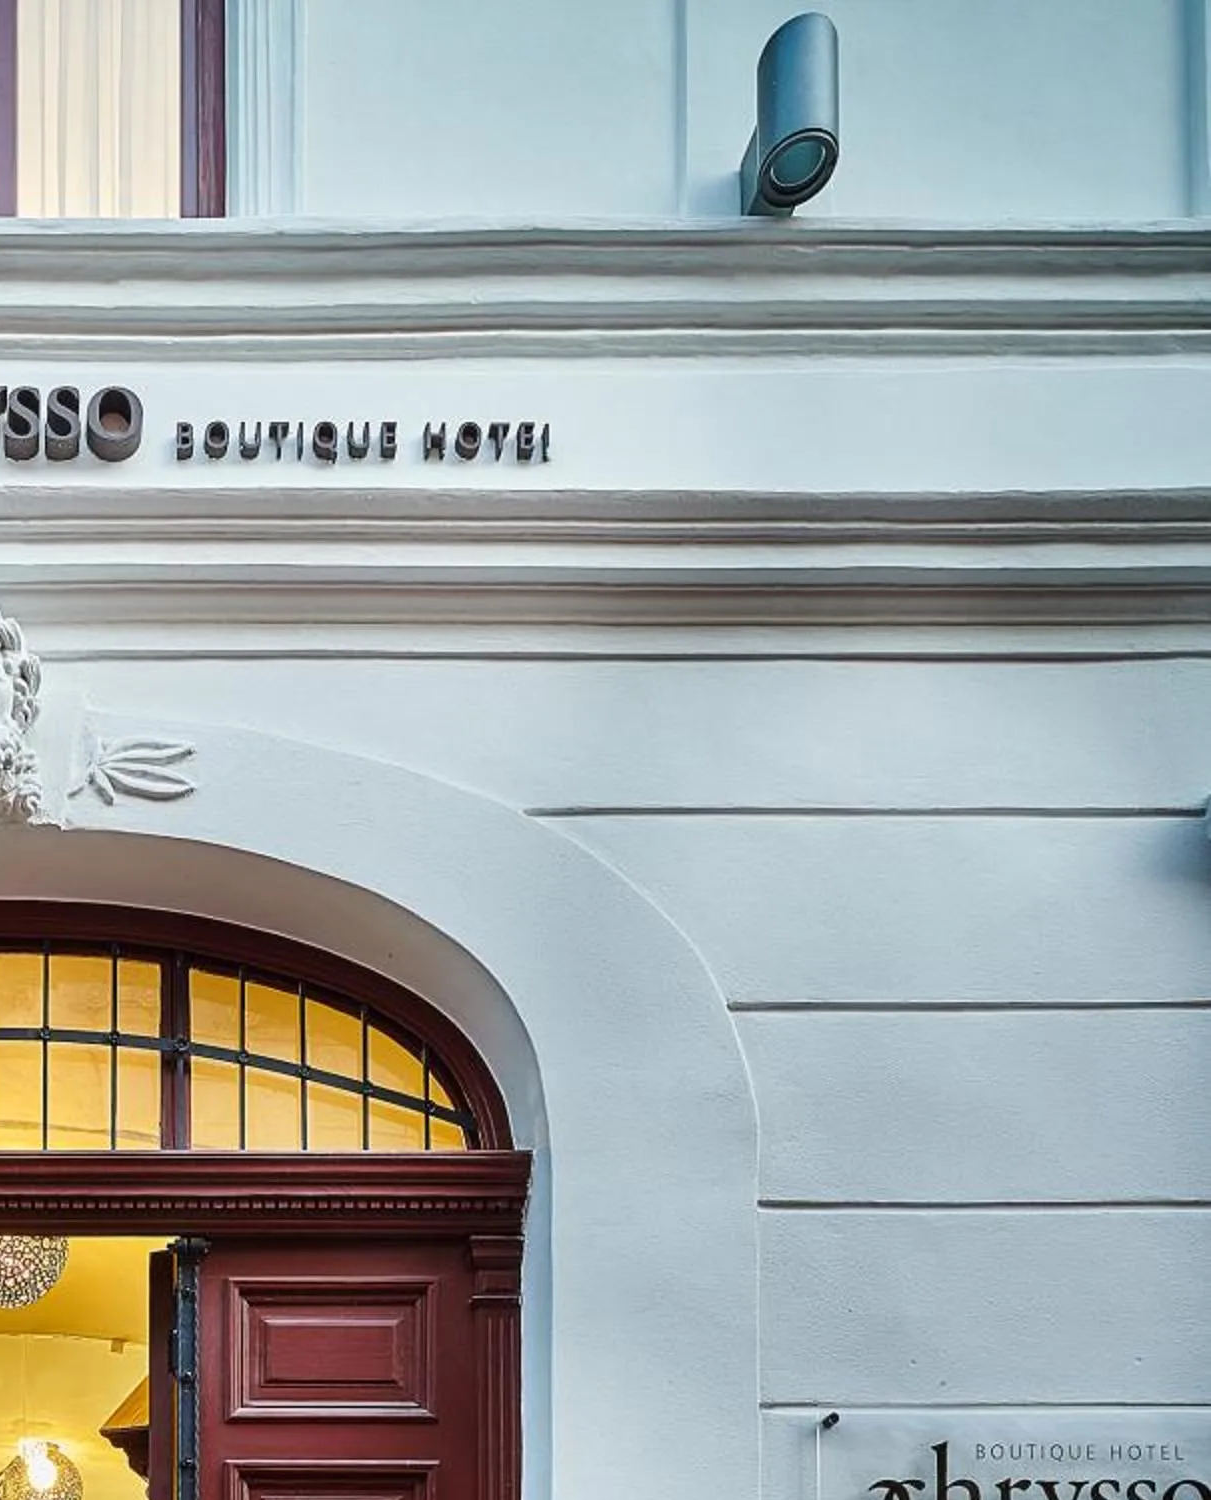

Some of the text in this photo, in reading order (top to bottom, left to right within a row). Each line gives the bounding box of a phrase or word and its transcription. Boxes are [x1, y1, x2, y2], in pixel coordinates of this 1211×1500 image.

[176, 421, 397, 464] BOUTIQUE
[423, 421, 550, 463] HOTEL
[975, 1443, 1185, 1462] BOUTIQUE HOTEL
